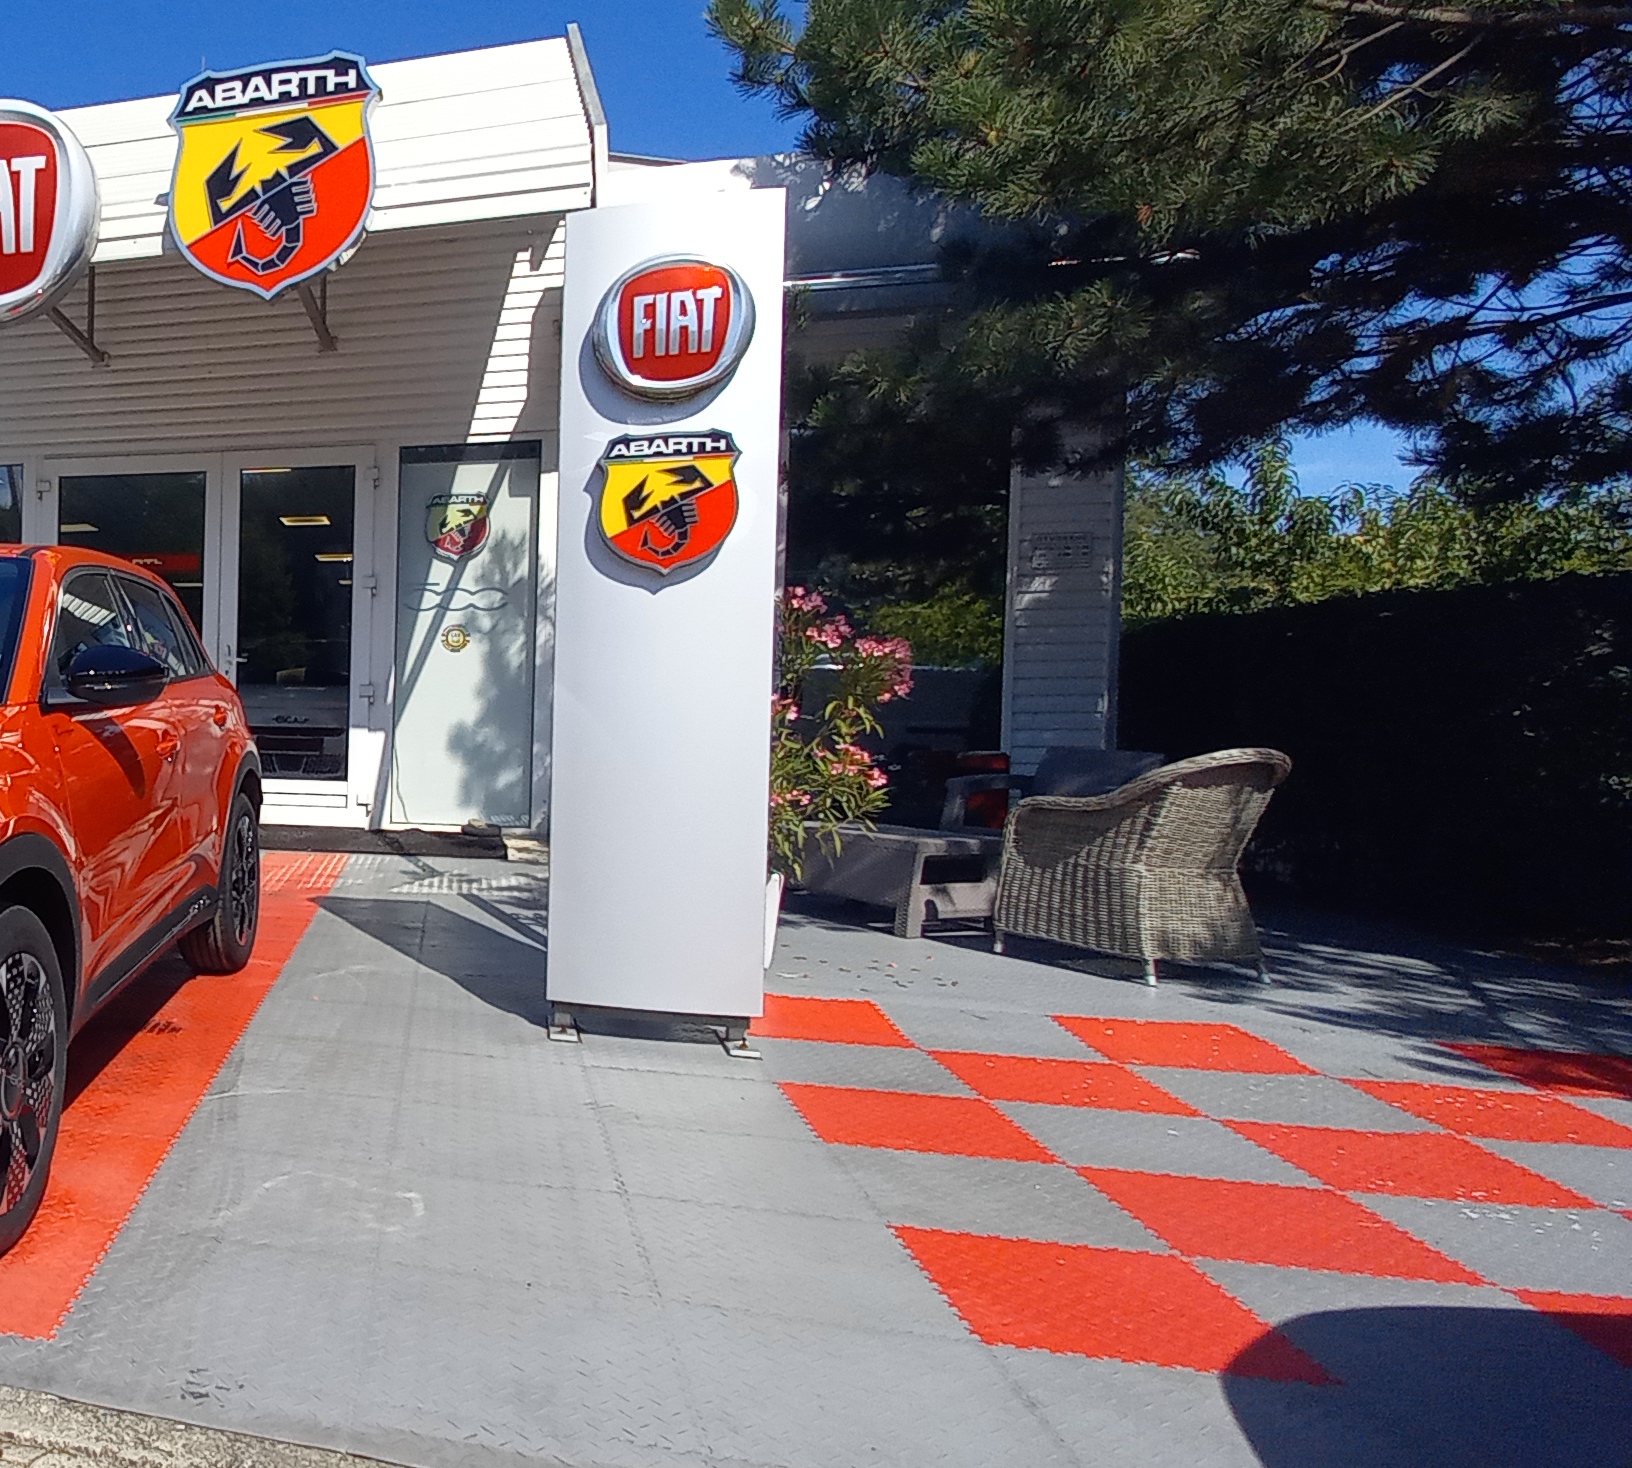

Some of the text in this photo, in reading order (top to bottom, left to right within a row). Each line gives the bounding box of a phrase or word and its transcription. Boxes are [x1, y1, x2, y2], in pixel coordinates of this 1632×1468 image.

[183, 68, 358, 114] ABARTH
[632, 286, 723, 359] FIAT
[609, 437, 727, 458] ABARTH
